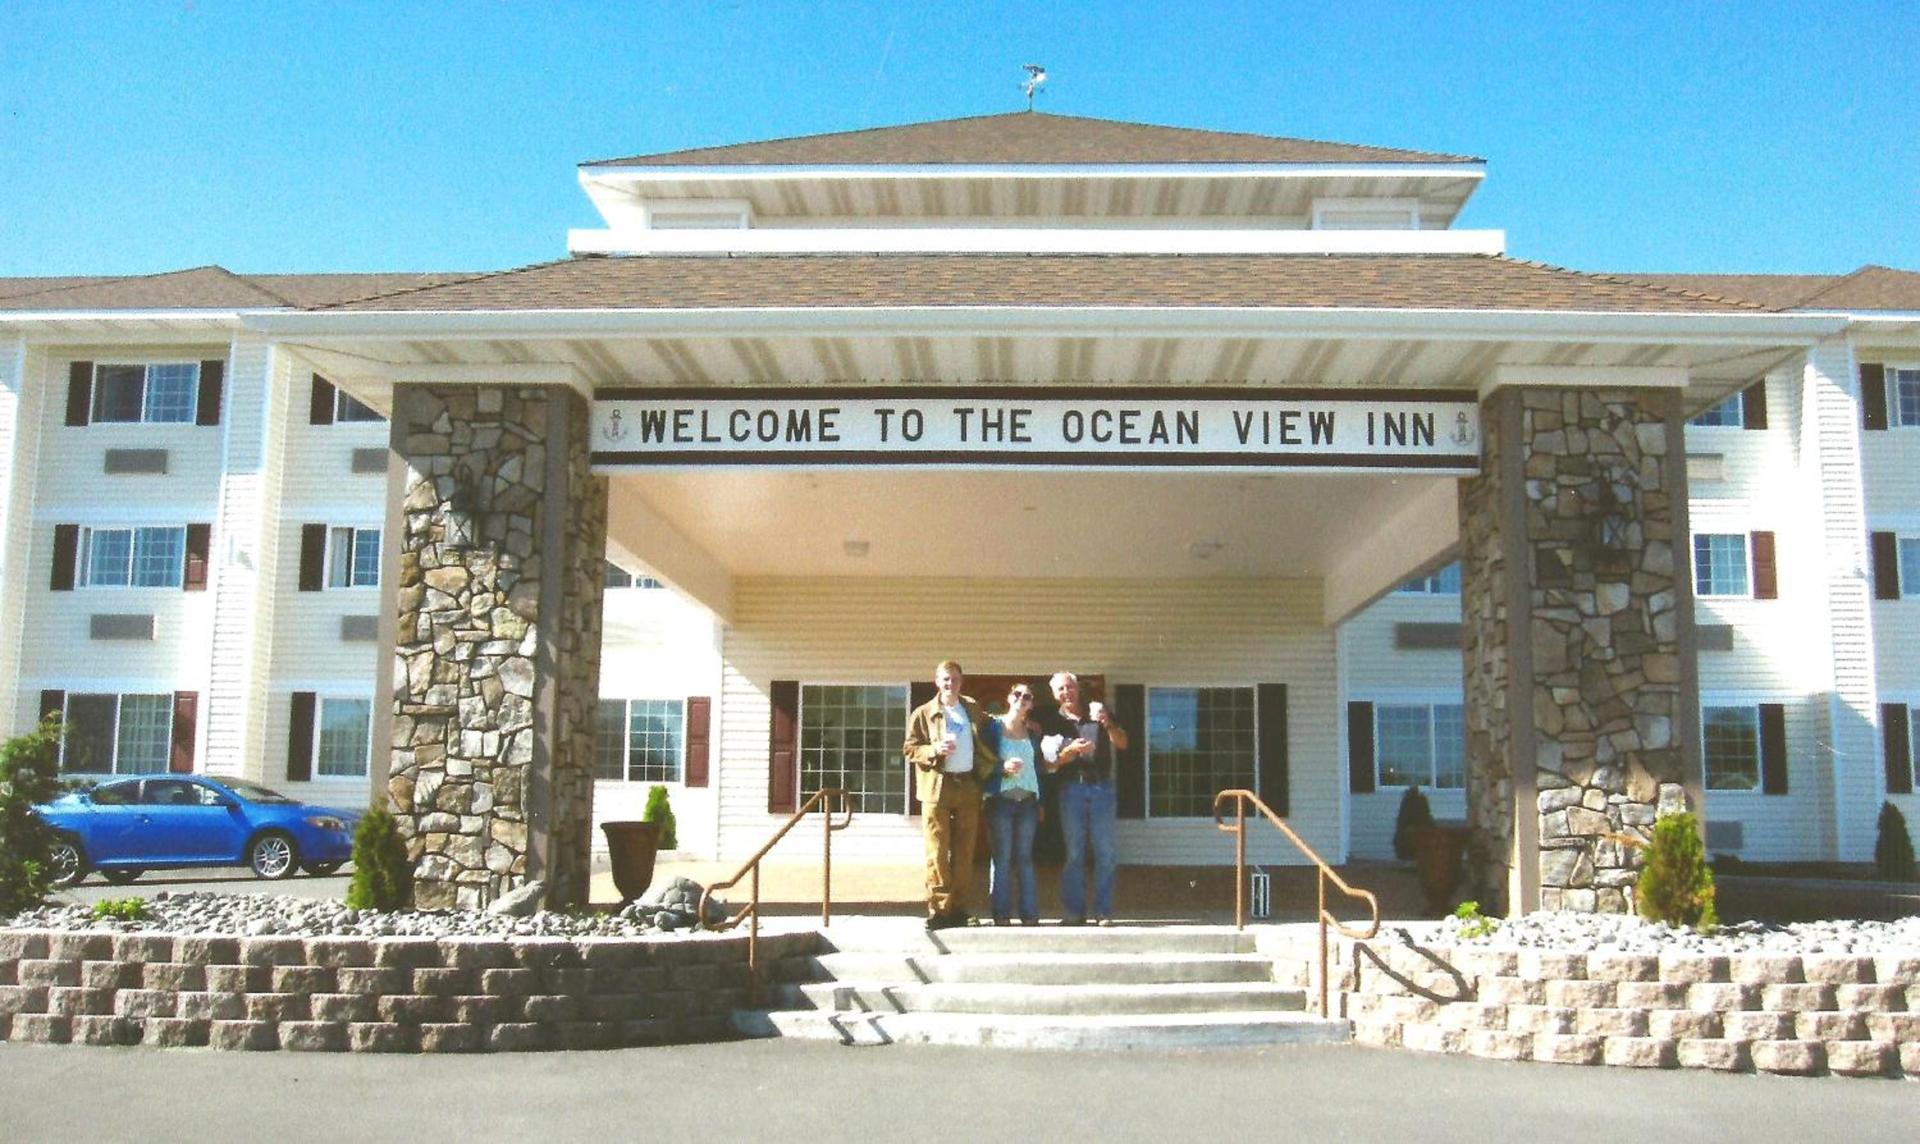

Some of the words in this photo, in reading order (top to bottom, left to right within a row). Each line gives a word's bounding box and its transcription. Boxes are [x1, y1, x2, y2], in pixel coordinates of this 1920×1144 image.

[640, 407, 841, 444] WELCOME
[873, 407, 924, 443] TO
[952, 407, 1033, 443] THE
[1062, 409, 1199, 445] OCEAN
[1232, 409, 1336, 446] VIEW
[1367, 411, 1435, 447] INN
